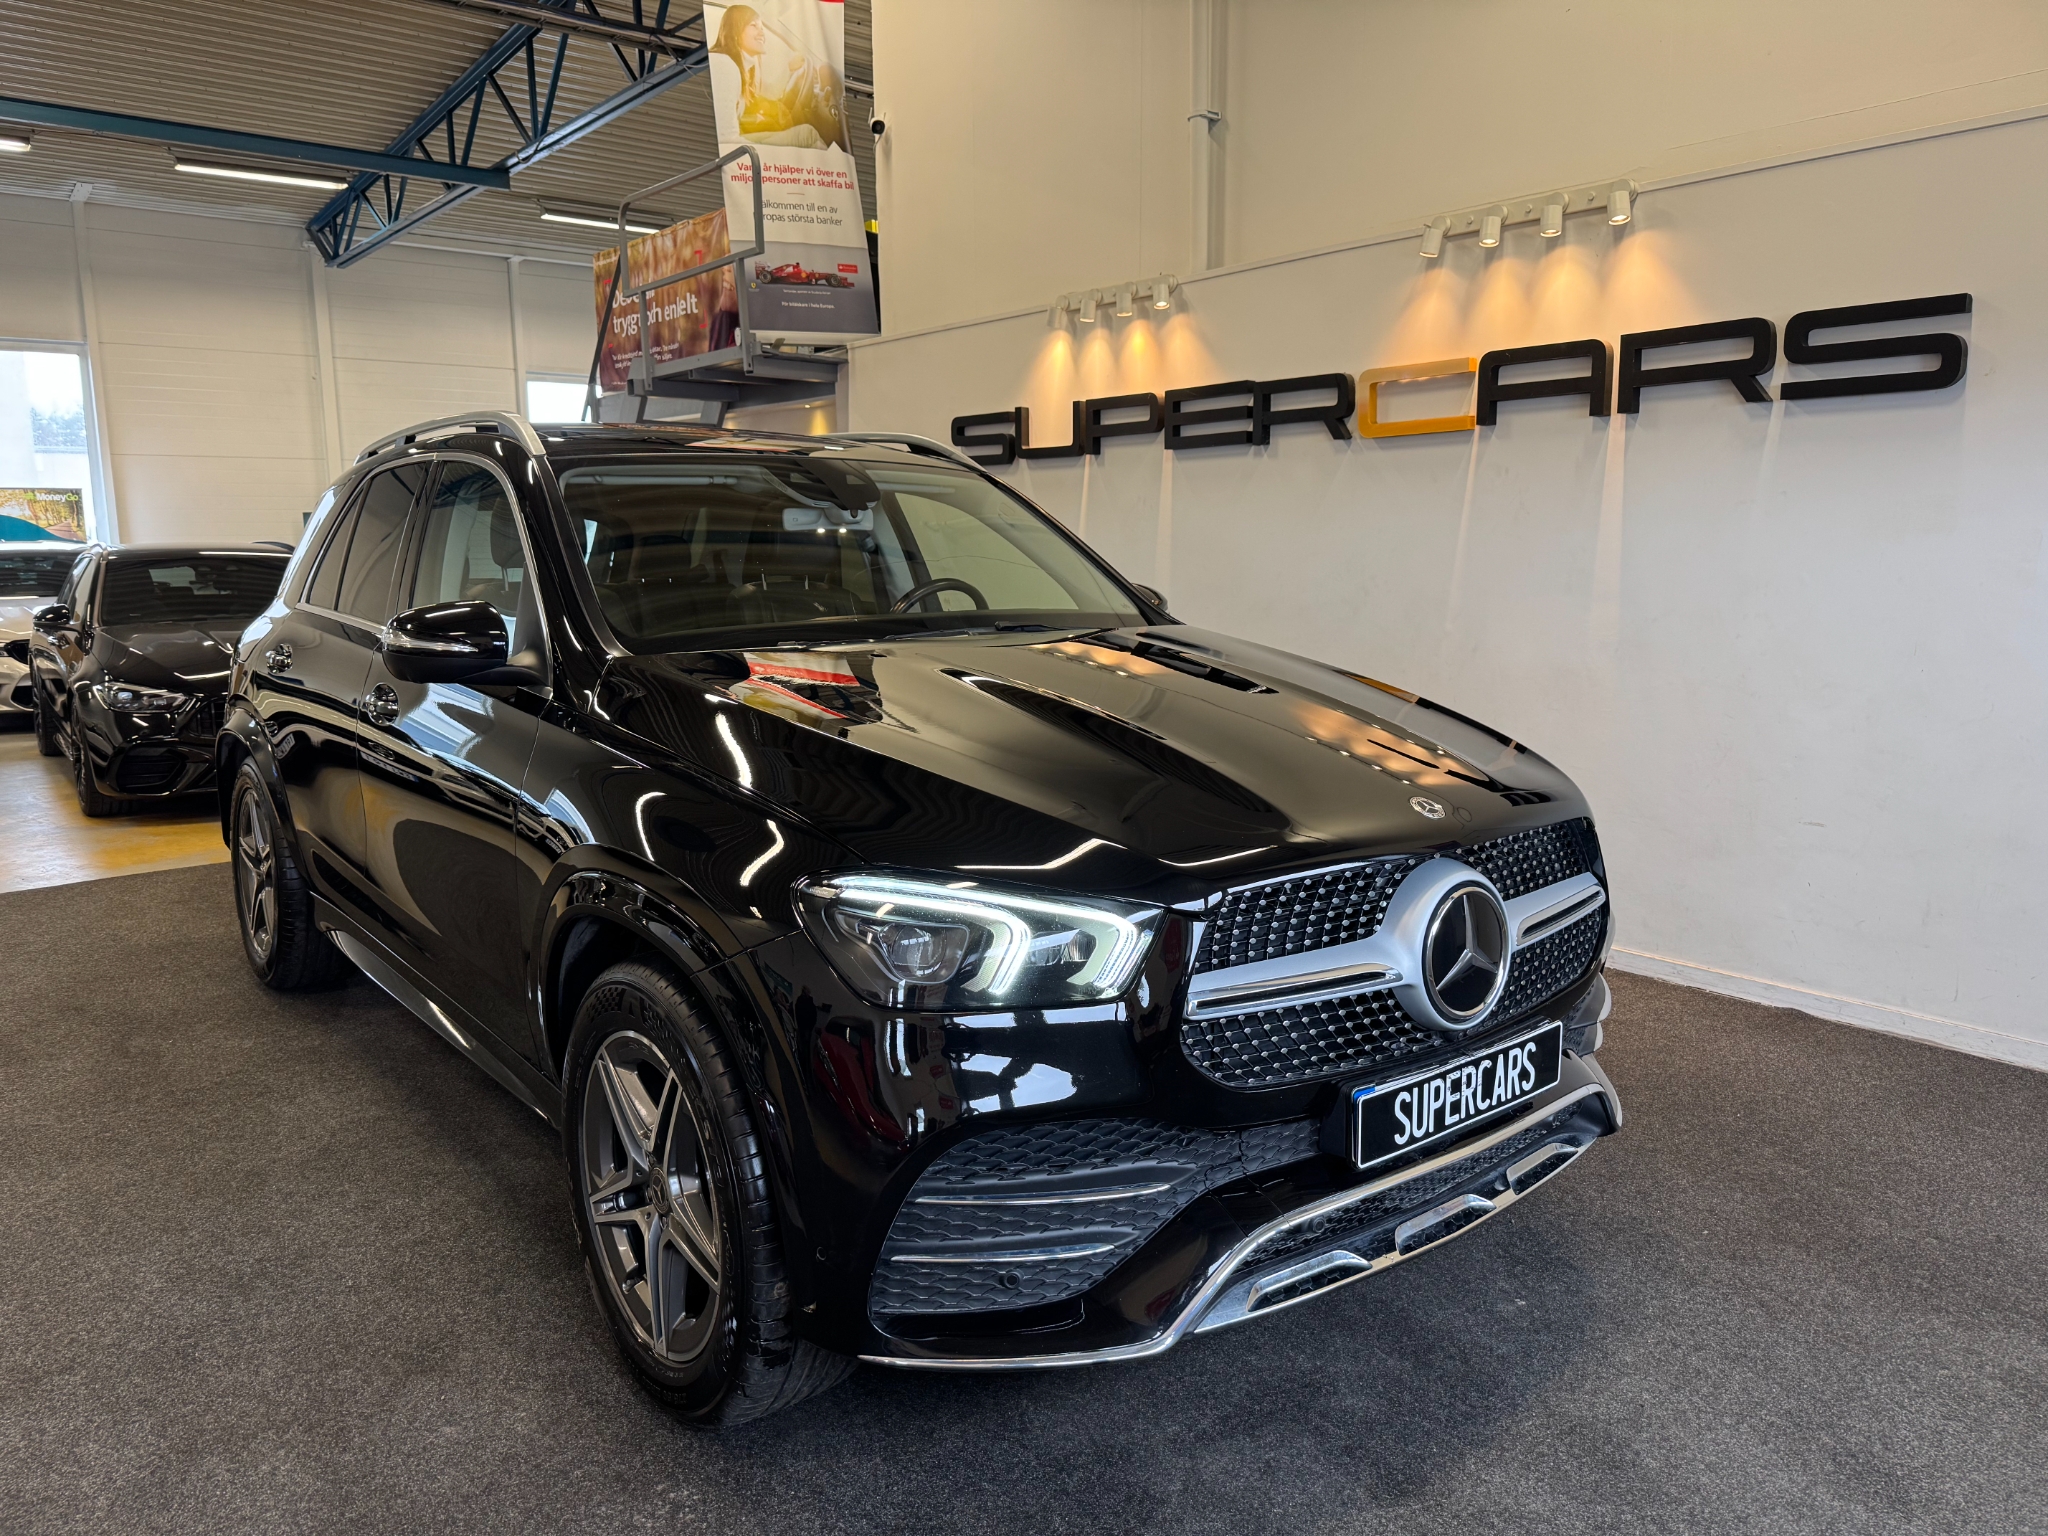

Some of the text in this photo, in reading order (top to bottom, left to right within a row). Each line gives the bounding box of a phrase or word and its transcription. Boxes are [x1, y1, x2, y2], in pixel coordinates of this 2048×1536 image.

[763, 162, 772, 172] år
[774, 163, 804, 176] hjälper
[806, 167, 814, 175] vi
[816, 167, 834, 178] över
[836, 171, 847, 179] en
[731, 173, 855, 190] miljo personer att skaffa bil
[761, 199, 838, 214] älkommen till en av
[762, 212, 843, 226] ropas största banker
[951, 293, 1973, 465] SUPERCARS
[36, 492, 79, 503] MoneyGo
[1394, 1042, 1536, 1145] SUPERCARS
